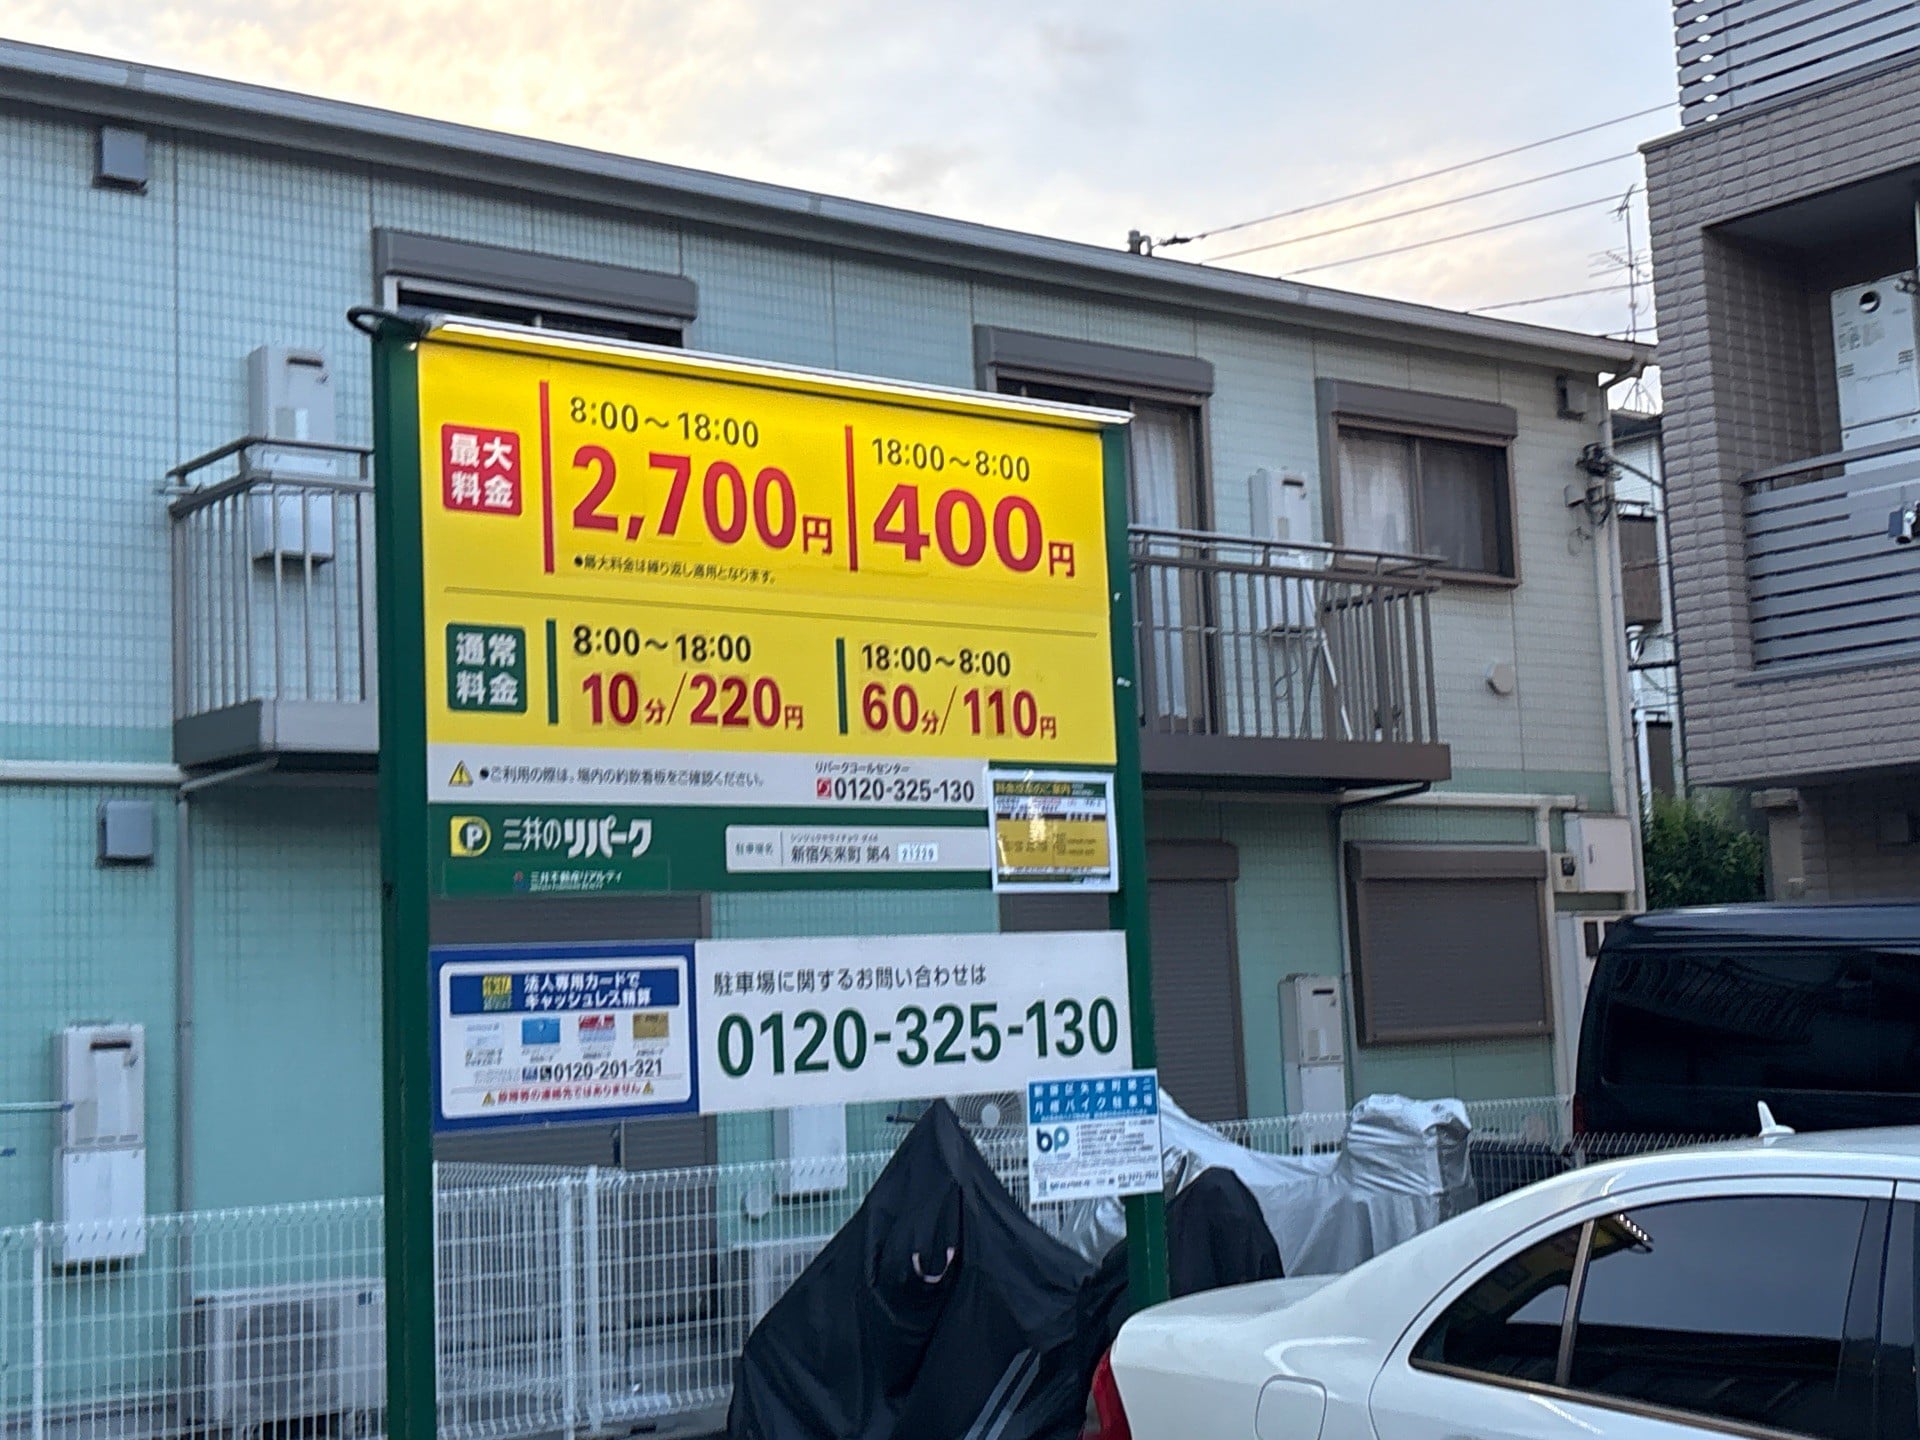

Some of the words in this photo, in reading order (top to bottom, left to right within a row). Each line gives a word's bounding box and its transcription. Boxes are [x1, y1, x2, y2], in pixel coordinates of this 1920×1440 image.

[449, 433, 514, 470] 最大
[451, 472, 515, 508] 料金
[572, 444, 833, 556] 2,700円
[873, 483, 1076, 578] 400円
[456, 631, 517, 667] 通常
[456, 670, 519, 706] 料金
[834, 777, 976, 803] 0120-325-130
[502, 814, 652, 858] 三井のリパーク
[523, 971, 641, 993] 法人専用カードで
[713, 965, 987, 997] 駐車場に関するお問い合わせは
[524, 988, 651, 1012] キャッシュレス精算
[716, 996, 1119, 1078] 0120-325-130
[553, 1057, 663, 1082] 0120-201-321
